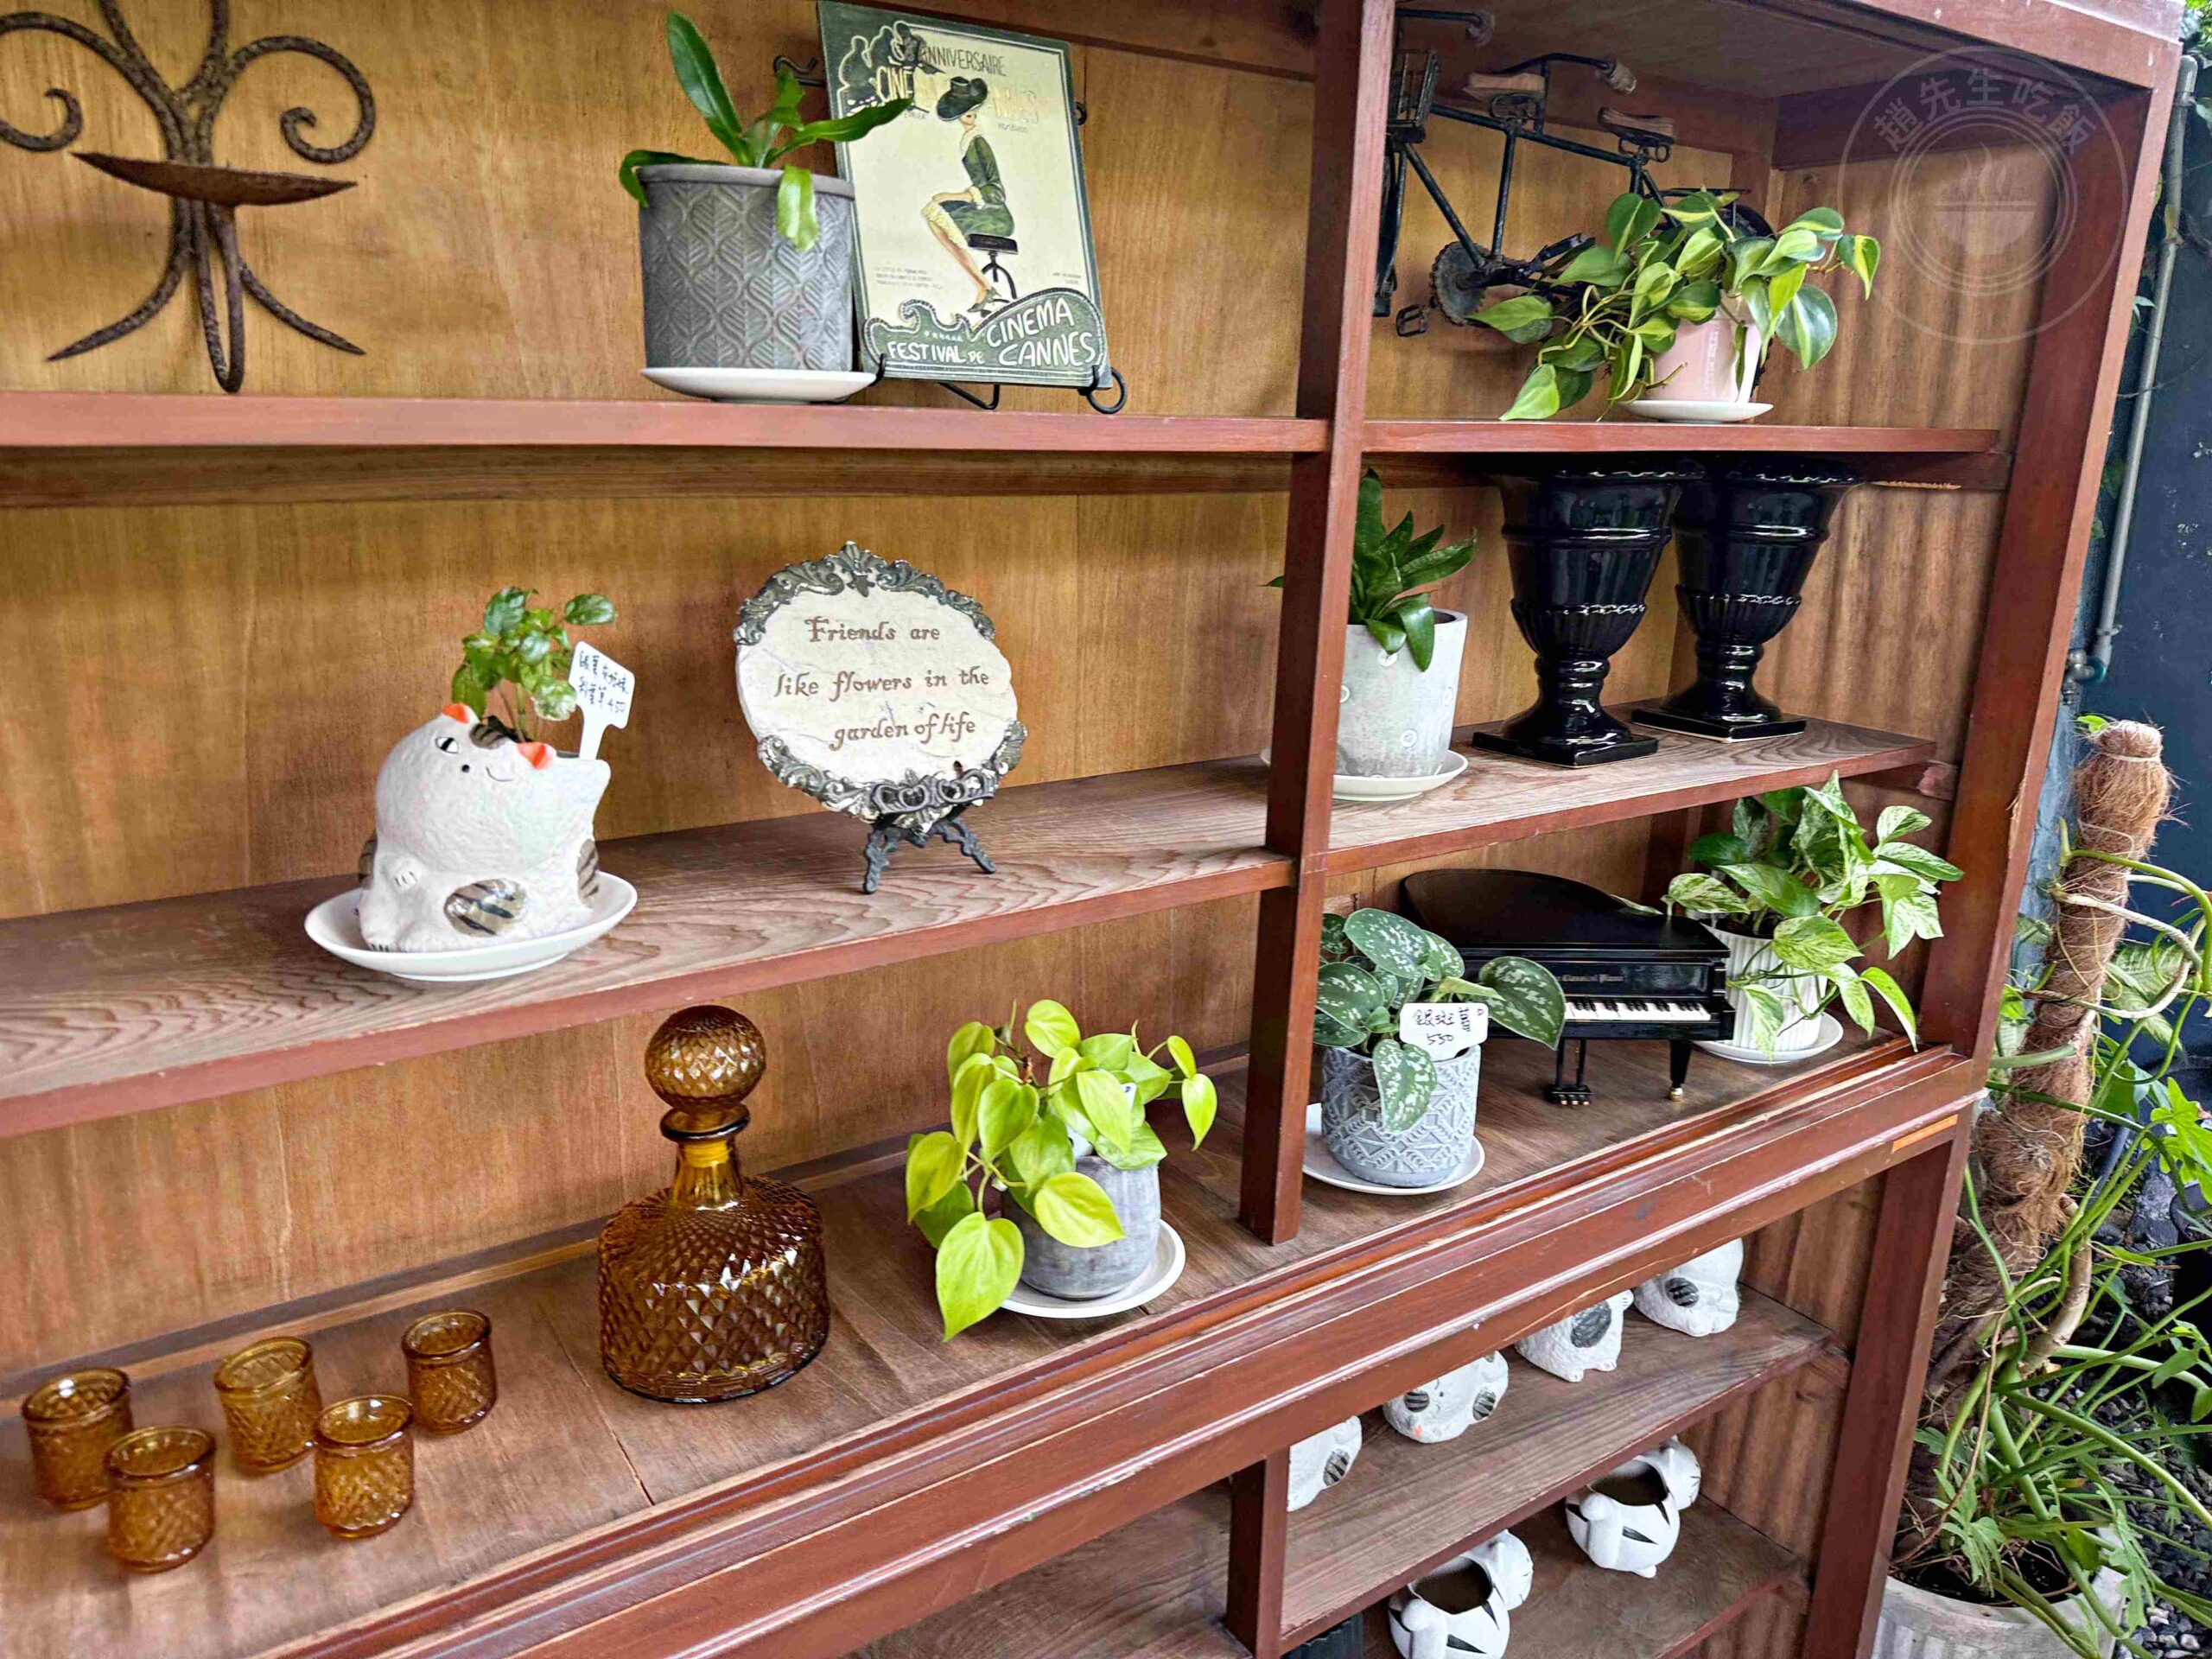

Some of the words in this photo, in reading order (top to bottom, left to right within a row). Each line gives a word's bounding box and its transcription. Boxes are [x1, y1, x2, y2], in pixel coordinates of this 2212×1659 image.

[986, 297, 1075, 347] CINEMA
[887, 341, 966, 365] FESTIVAL
[998, 331, 1096, 367] CANNES
[804, 616, 896, 643] Friends
[910, 627, 941, 641] are
[774, 671, 819, 697] like
[829, 671, 912, 702] flowers
[925, 670, 948, 687] in
[958, 664, 990, 686] the
[828, 718, 909, 753] garden
[914, 713, 939, 745] of
[939, 711, 976, 742] life
[1427, 1033, 1455, 1046] 550
